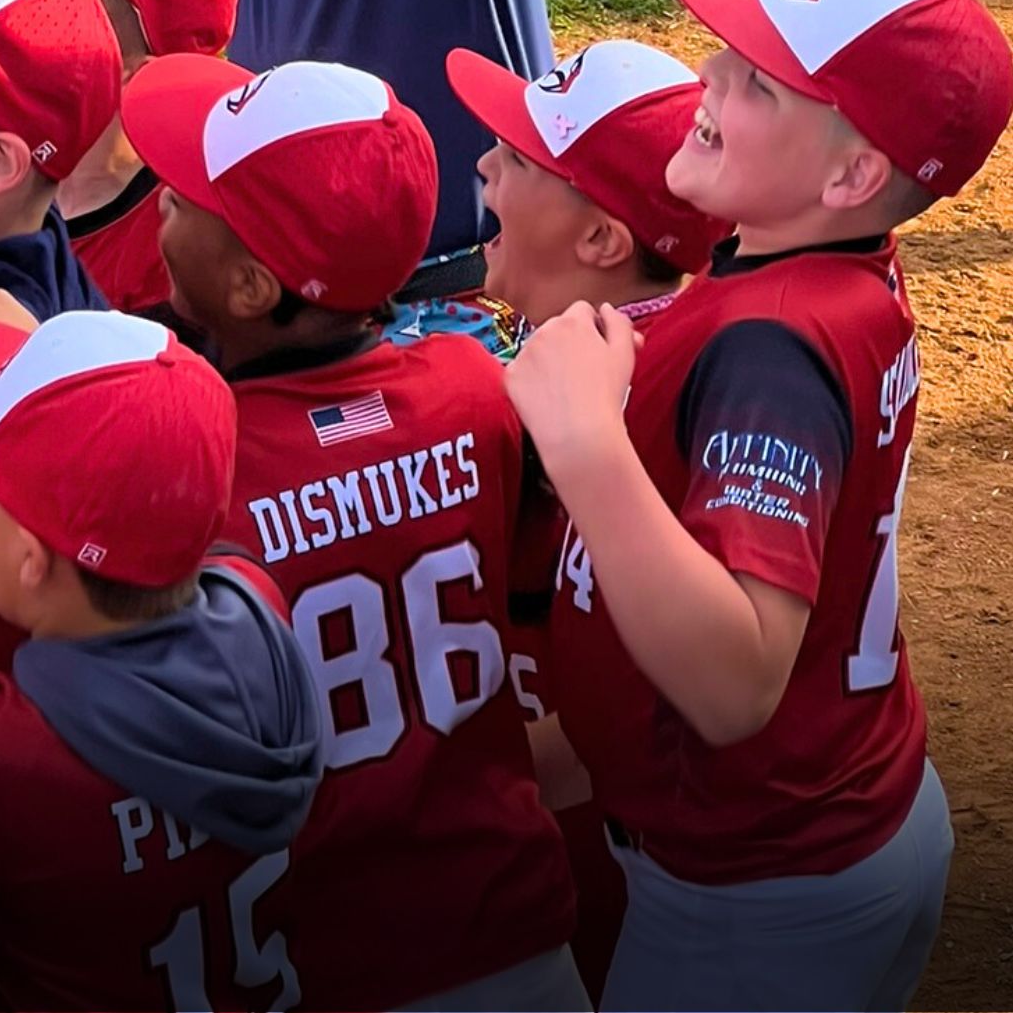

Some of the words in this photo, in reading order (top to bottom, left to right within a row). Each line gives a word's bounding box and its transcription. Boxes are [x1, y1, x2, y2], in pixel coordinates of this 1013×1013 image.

[248, 431, 482, 565] DISMUKES
[291, 539, 505, 770] 86
[111, 796, 210, 873] PI
